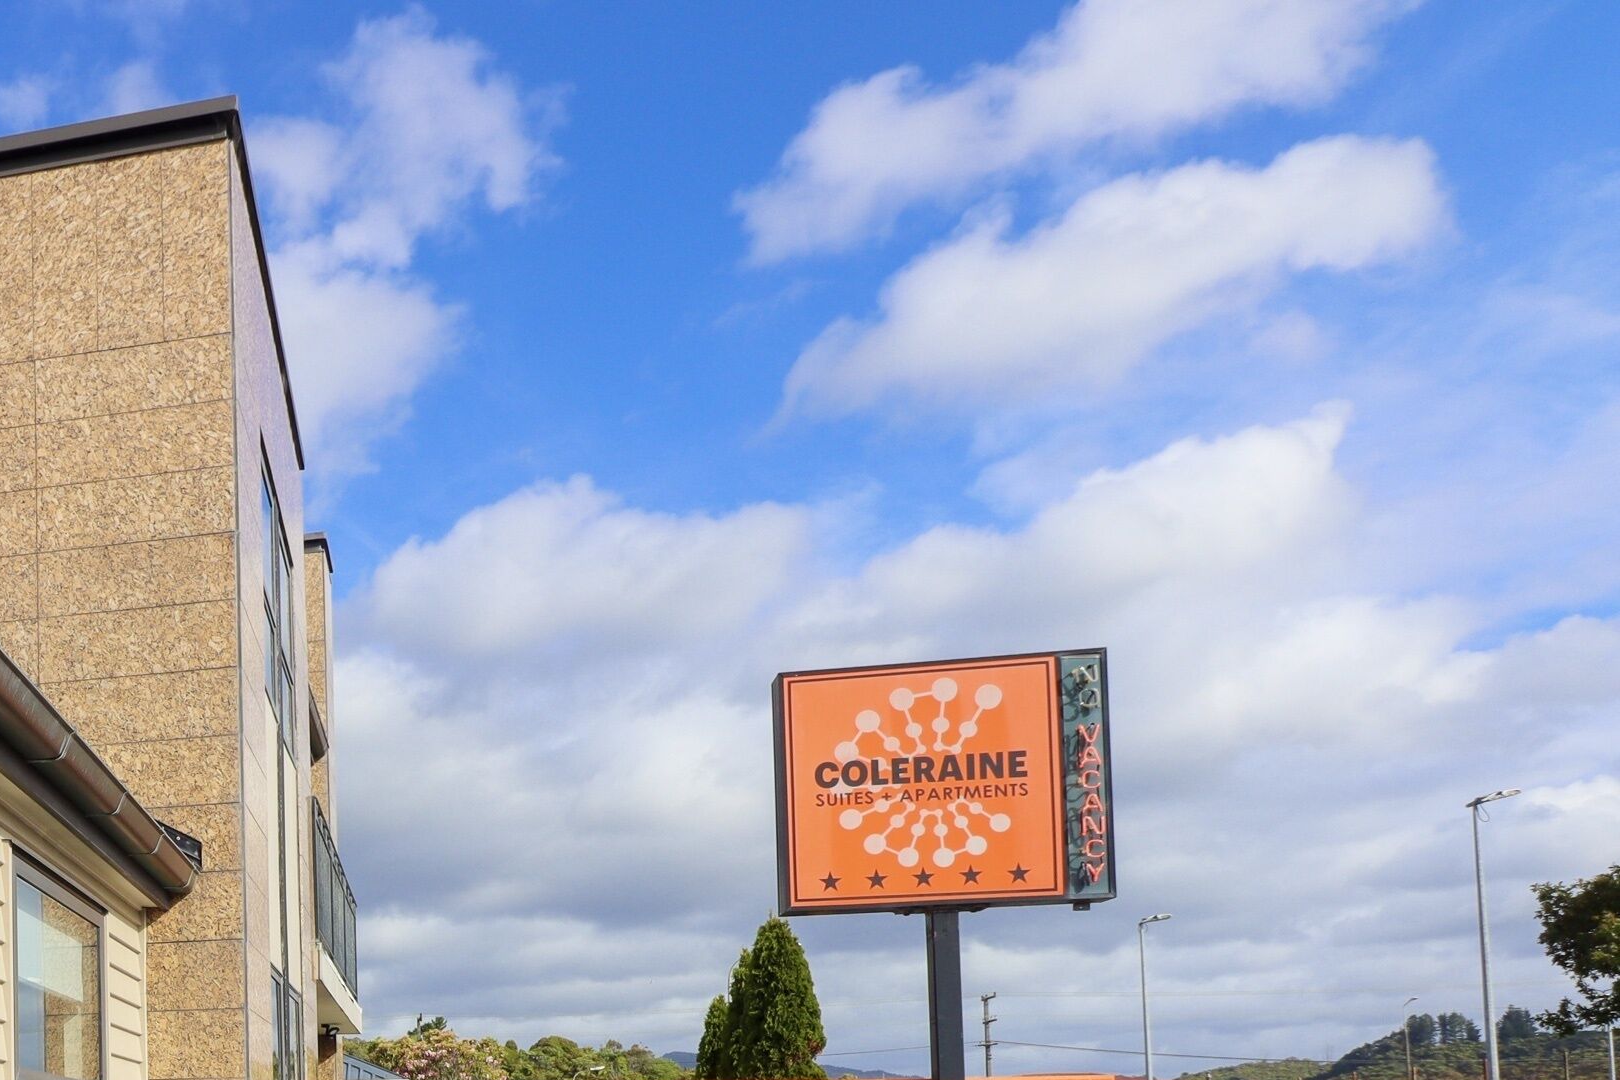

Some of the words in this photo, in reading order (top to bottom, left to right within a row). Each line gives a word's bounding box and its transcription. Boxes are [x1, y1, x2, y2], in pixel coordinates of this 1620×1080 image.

[814, 749, 1029, 789] COLERAINE
[815, 790, 874, 807] SUITES
[898, 782, 1029, 802] APARTMENTS
[1077, 723, 1106, 885] VACANCY
